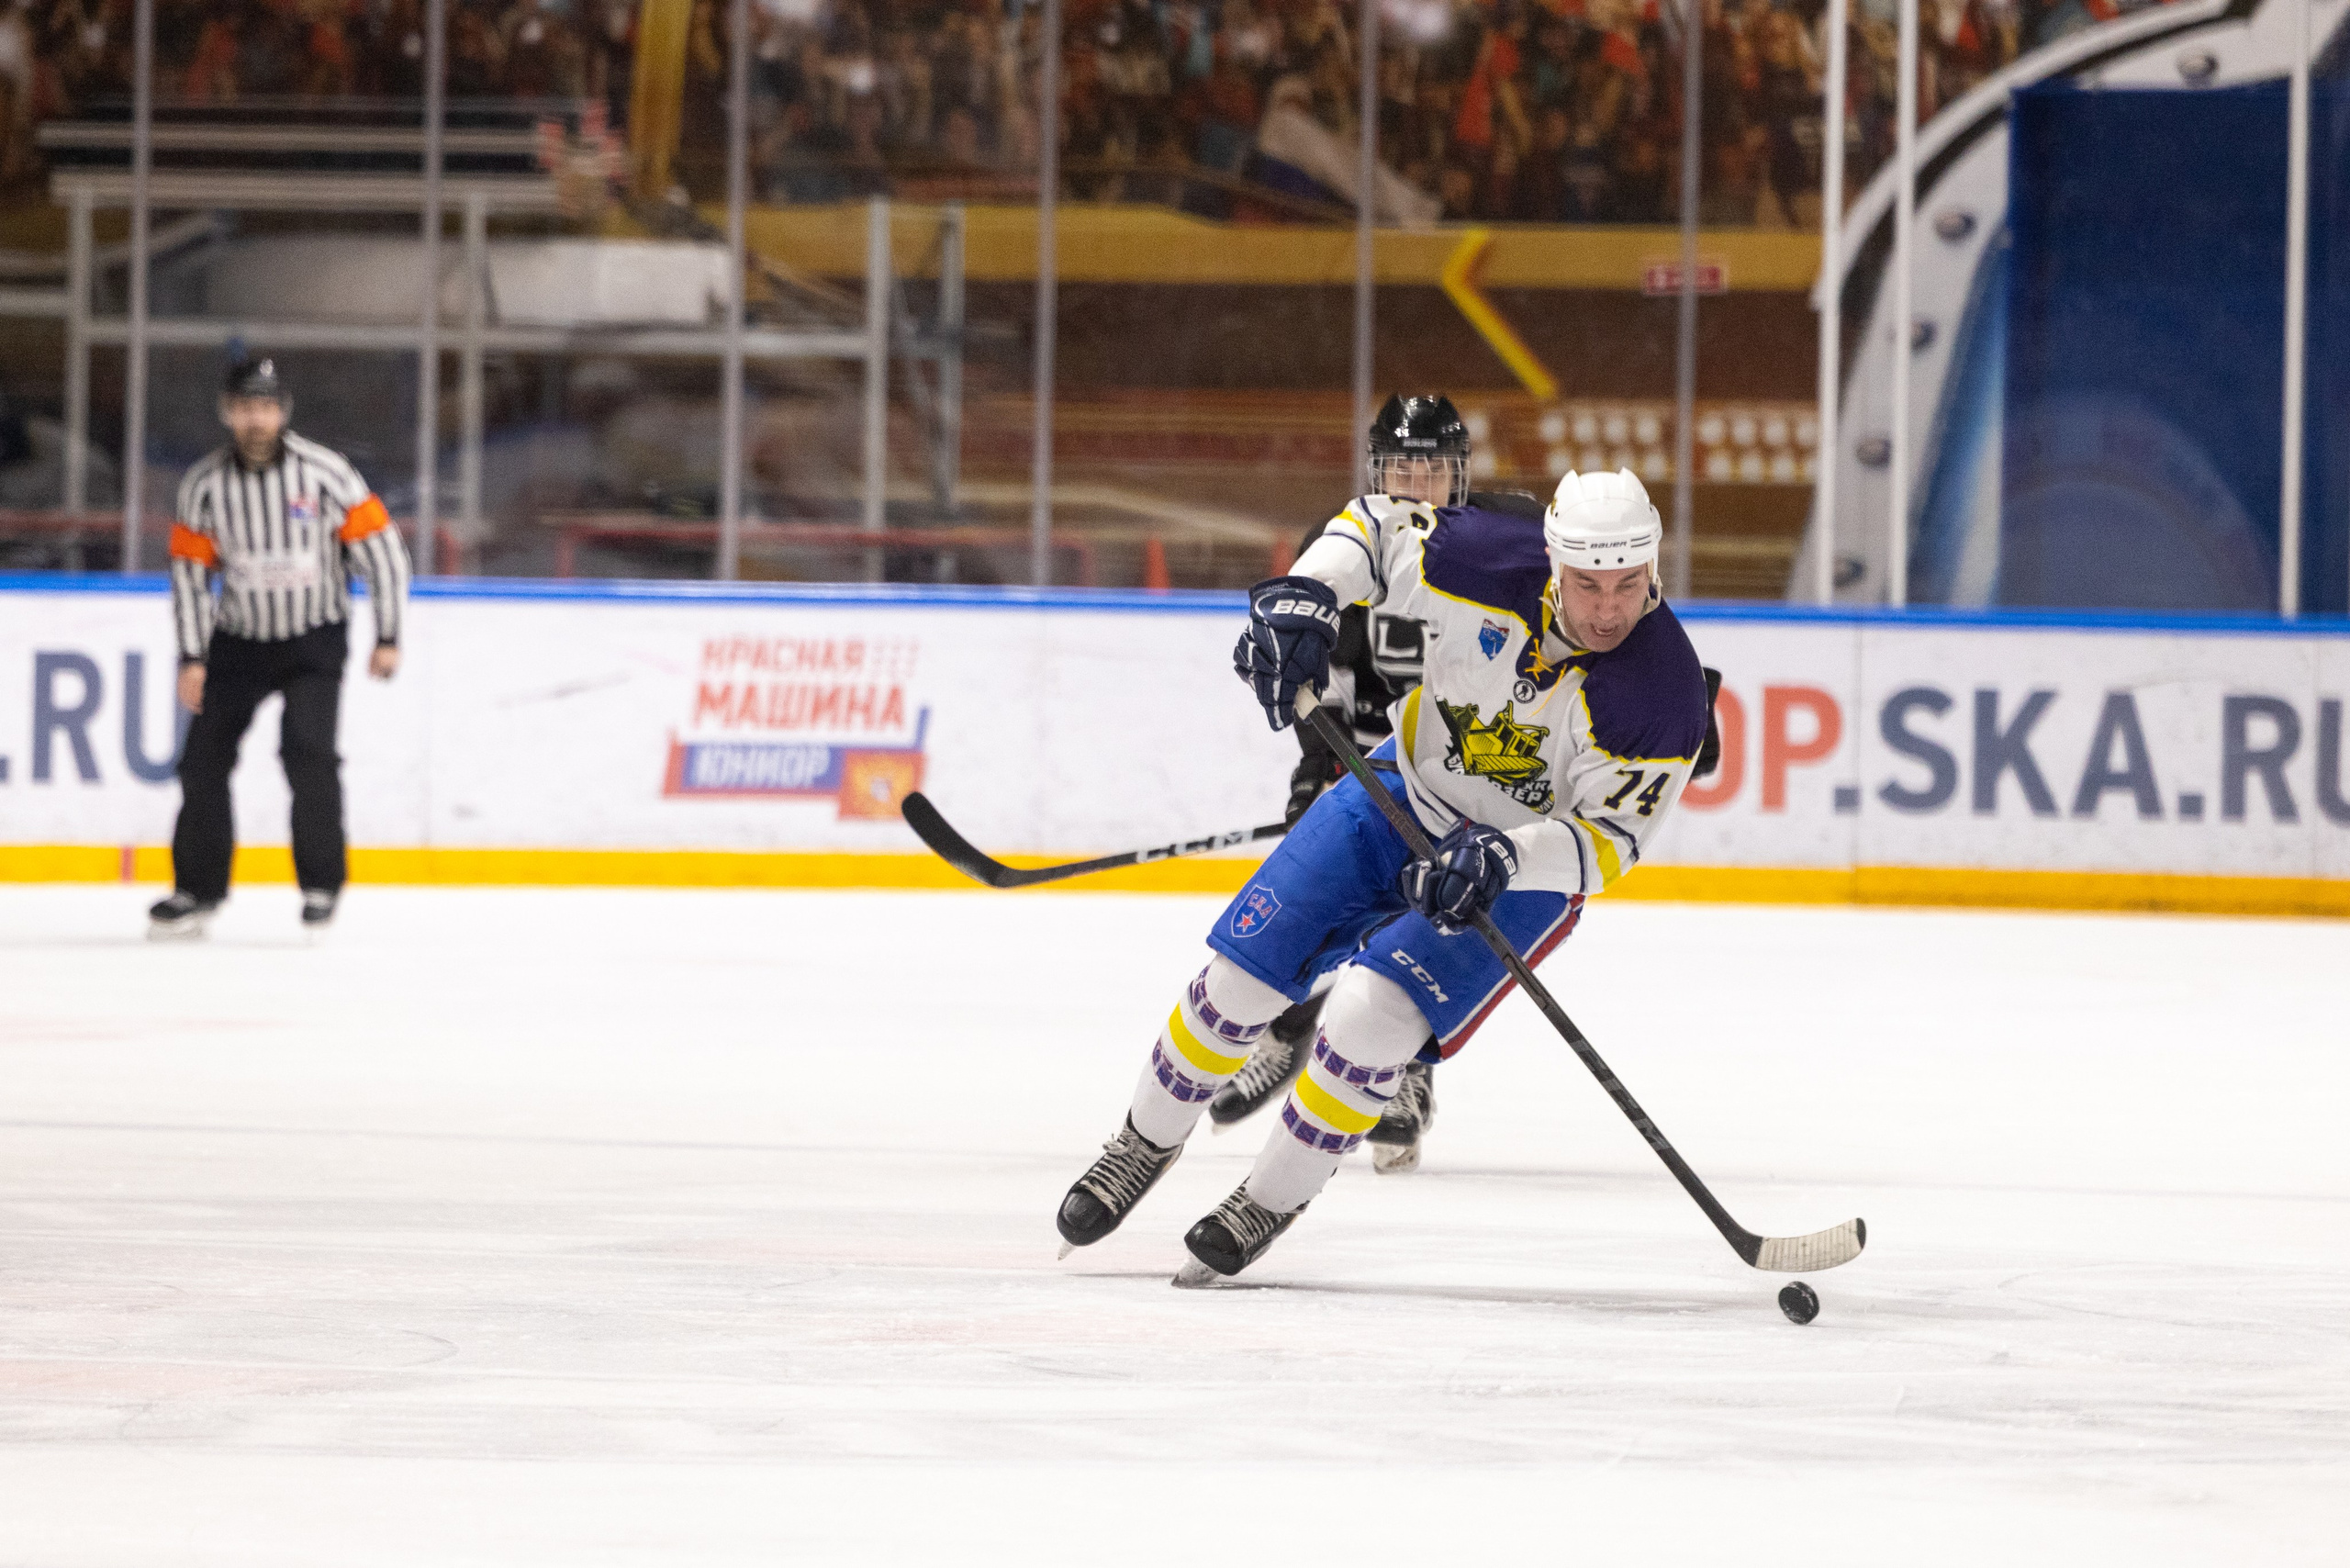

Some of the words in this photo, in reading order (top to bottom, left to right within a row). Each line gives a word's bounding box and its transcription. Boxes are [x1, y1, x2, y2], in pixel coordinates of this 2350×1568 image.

[1590, 541, 1628, 549] BAUER
[692, 682, 905, 731] МАШИНА
[1603, 768, 1672, 816] 74
[1391, 948, 1449, 1003] CCM
